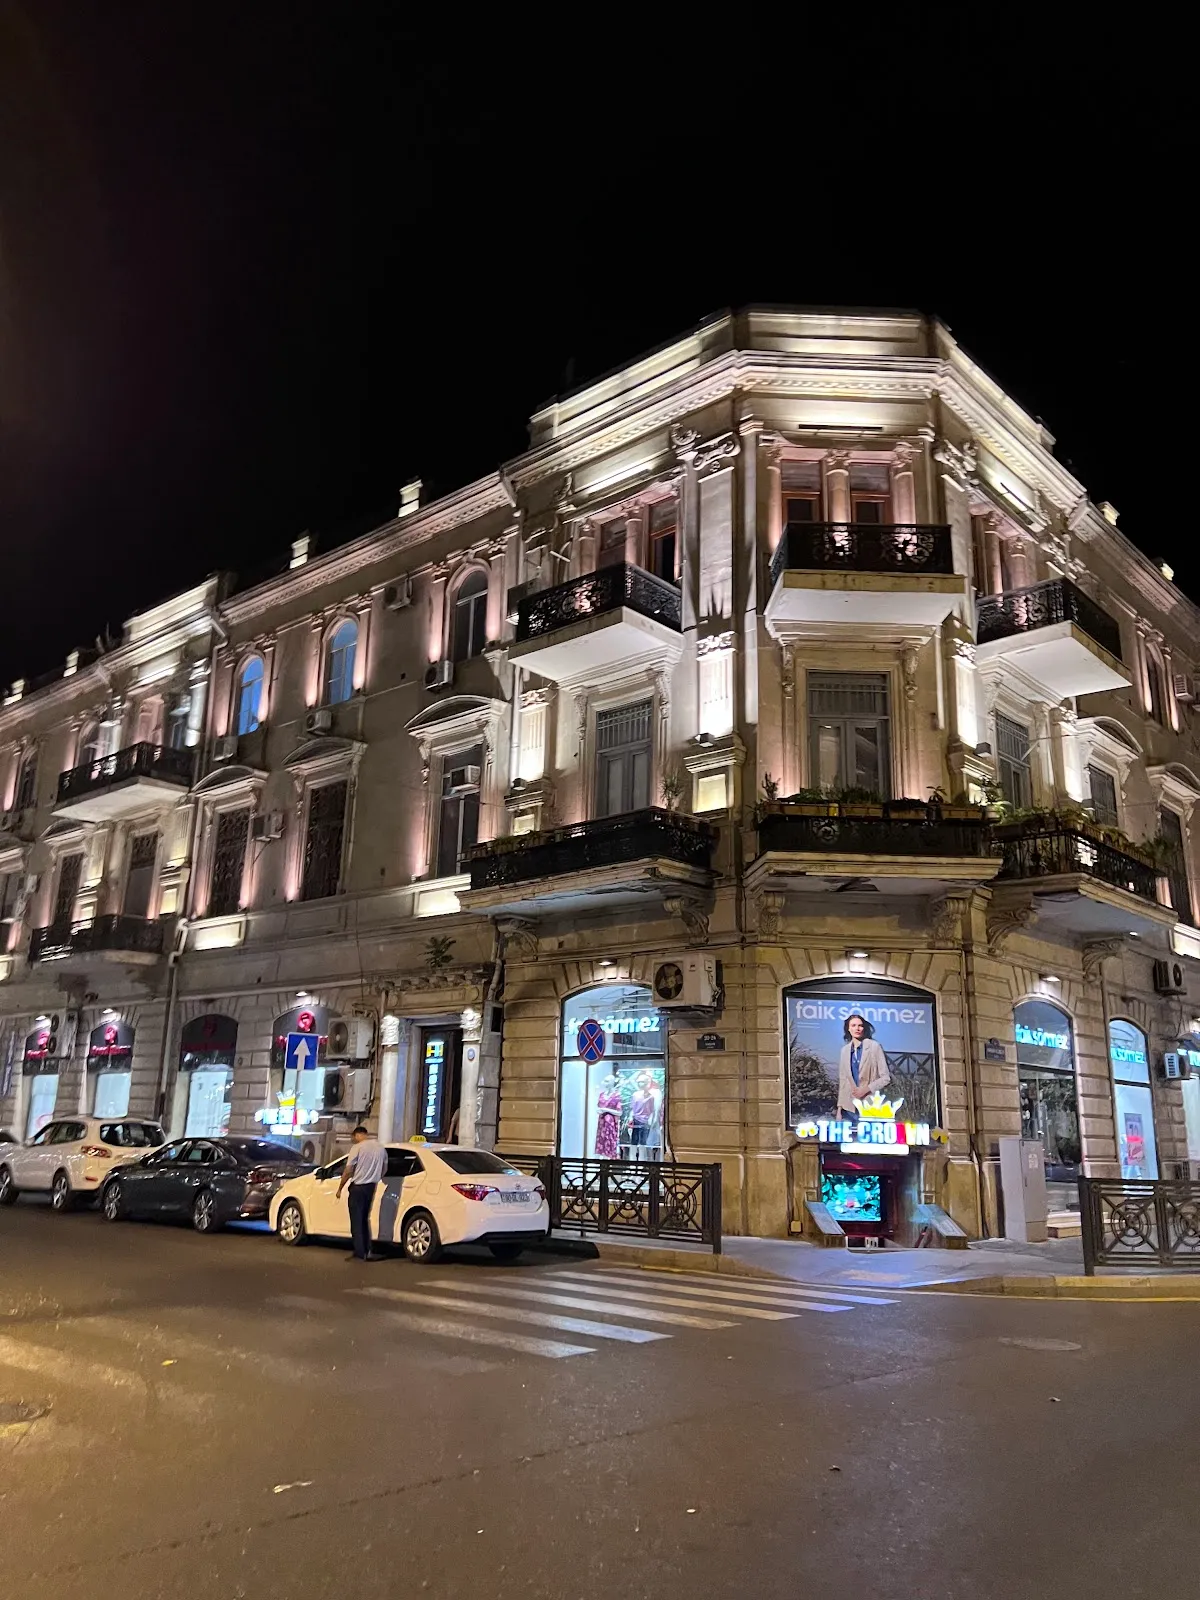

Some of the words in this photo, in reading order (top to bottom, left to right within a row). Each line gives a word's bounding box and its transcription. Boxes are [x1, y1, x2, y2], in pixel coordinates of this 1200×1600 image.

[796, 1000, 836, 1020] faik
[838, 1003, 926, 1024] sönmez
[425, 1063, 439, 1128] HOSTEL
[817, 1120, 853, 1143] THE
[857, 1121, 930, 1146] CROWN
